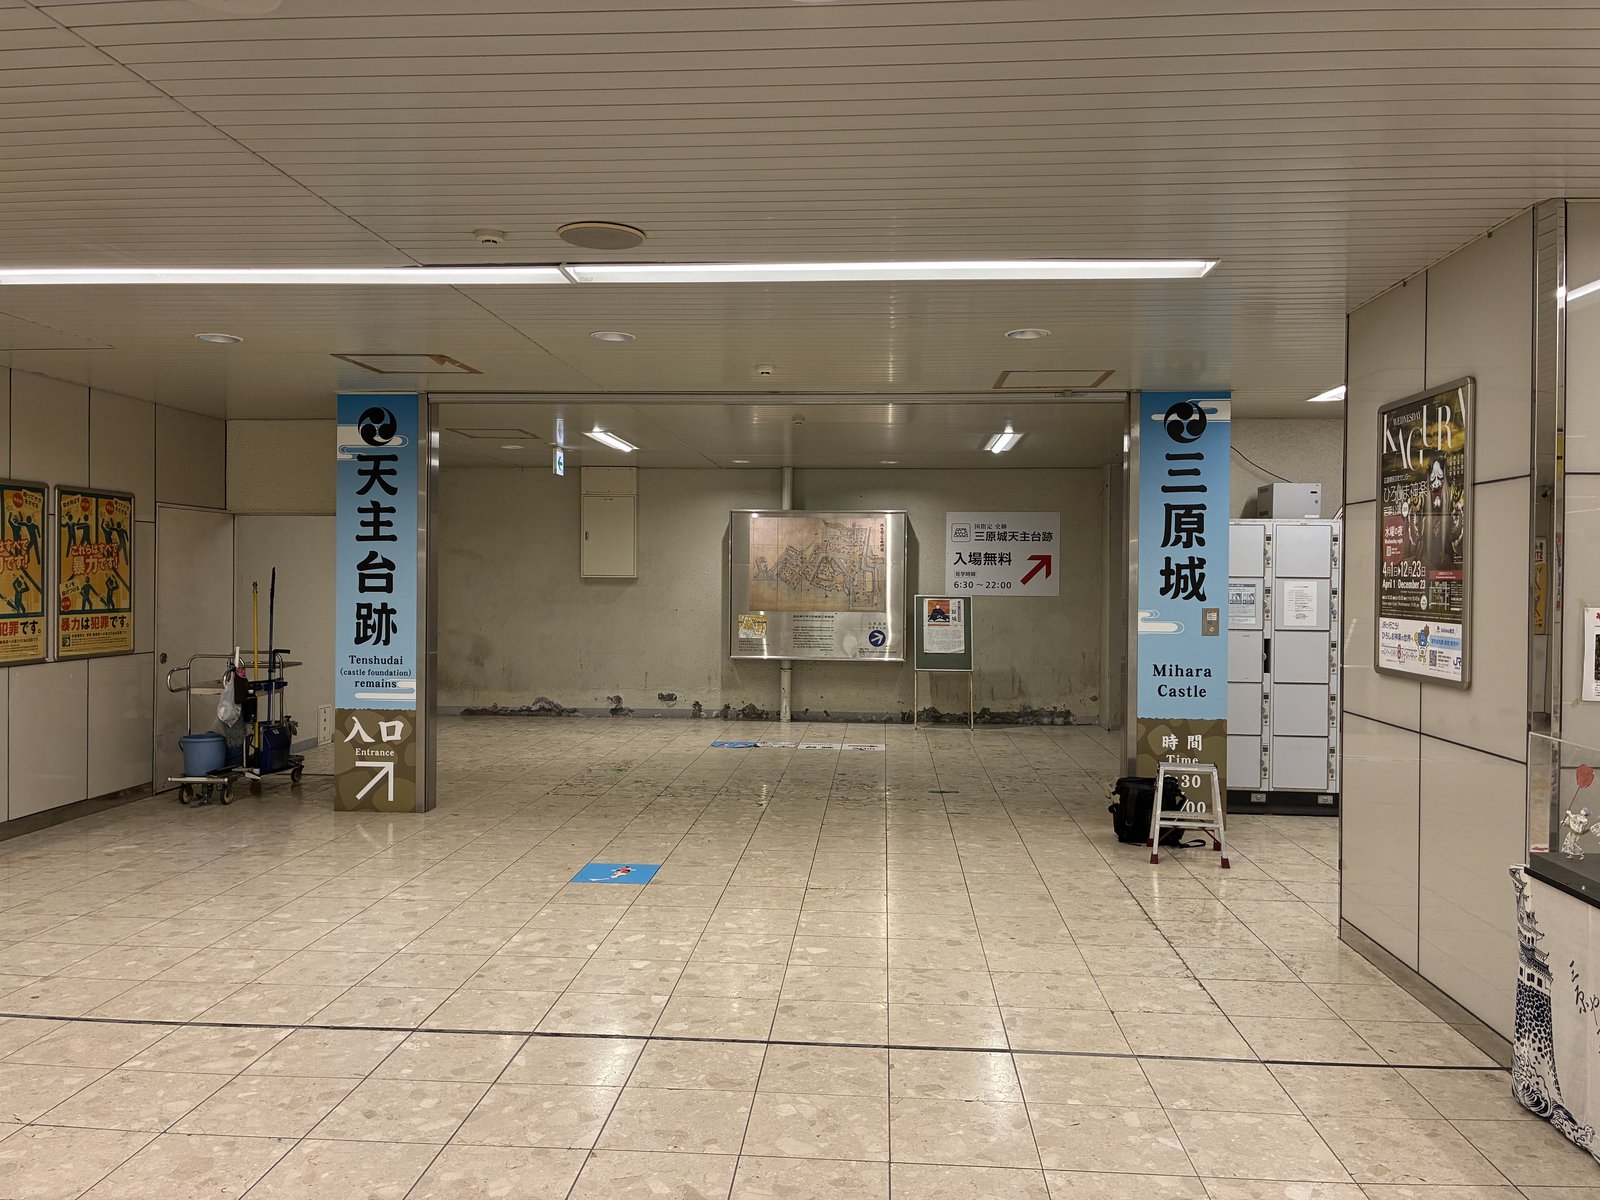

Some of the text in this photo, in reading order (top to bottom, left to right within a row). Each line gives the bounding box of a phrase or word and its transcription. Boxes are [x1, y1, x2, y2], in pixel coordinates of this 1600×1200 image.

[1393, 410, 1422, 426] WEDNESDAY
[1383, 387, 1465, 471] KAGURA
[1160, 452, 1207, 602] 三原城
[974, 531, 1053, 542] 三原城天主台跡
[354, 454, 399, 646] 天主台跡
[953, 552, 1012, 566] 入場無料
[60, 615, 129, 632] 暴力は犯罪です。
[349, 655, 403, 665] Tenshudai
[340, 667, 412, 677] (castle foundation)
[1152, 664, 1212, 678] Mihara
[354, 679, 397, 688] remains
[1157, 684, 1207, 698] Castle
[343, 716, 405, 743] 入口
[355, 747, 395, 757] Entrance
